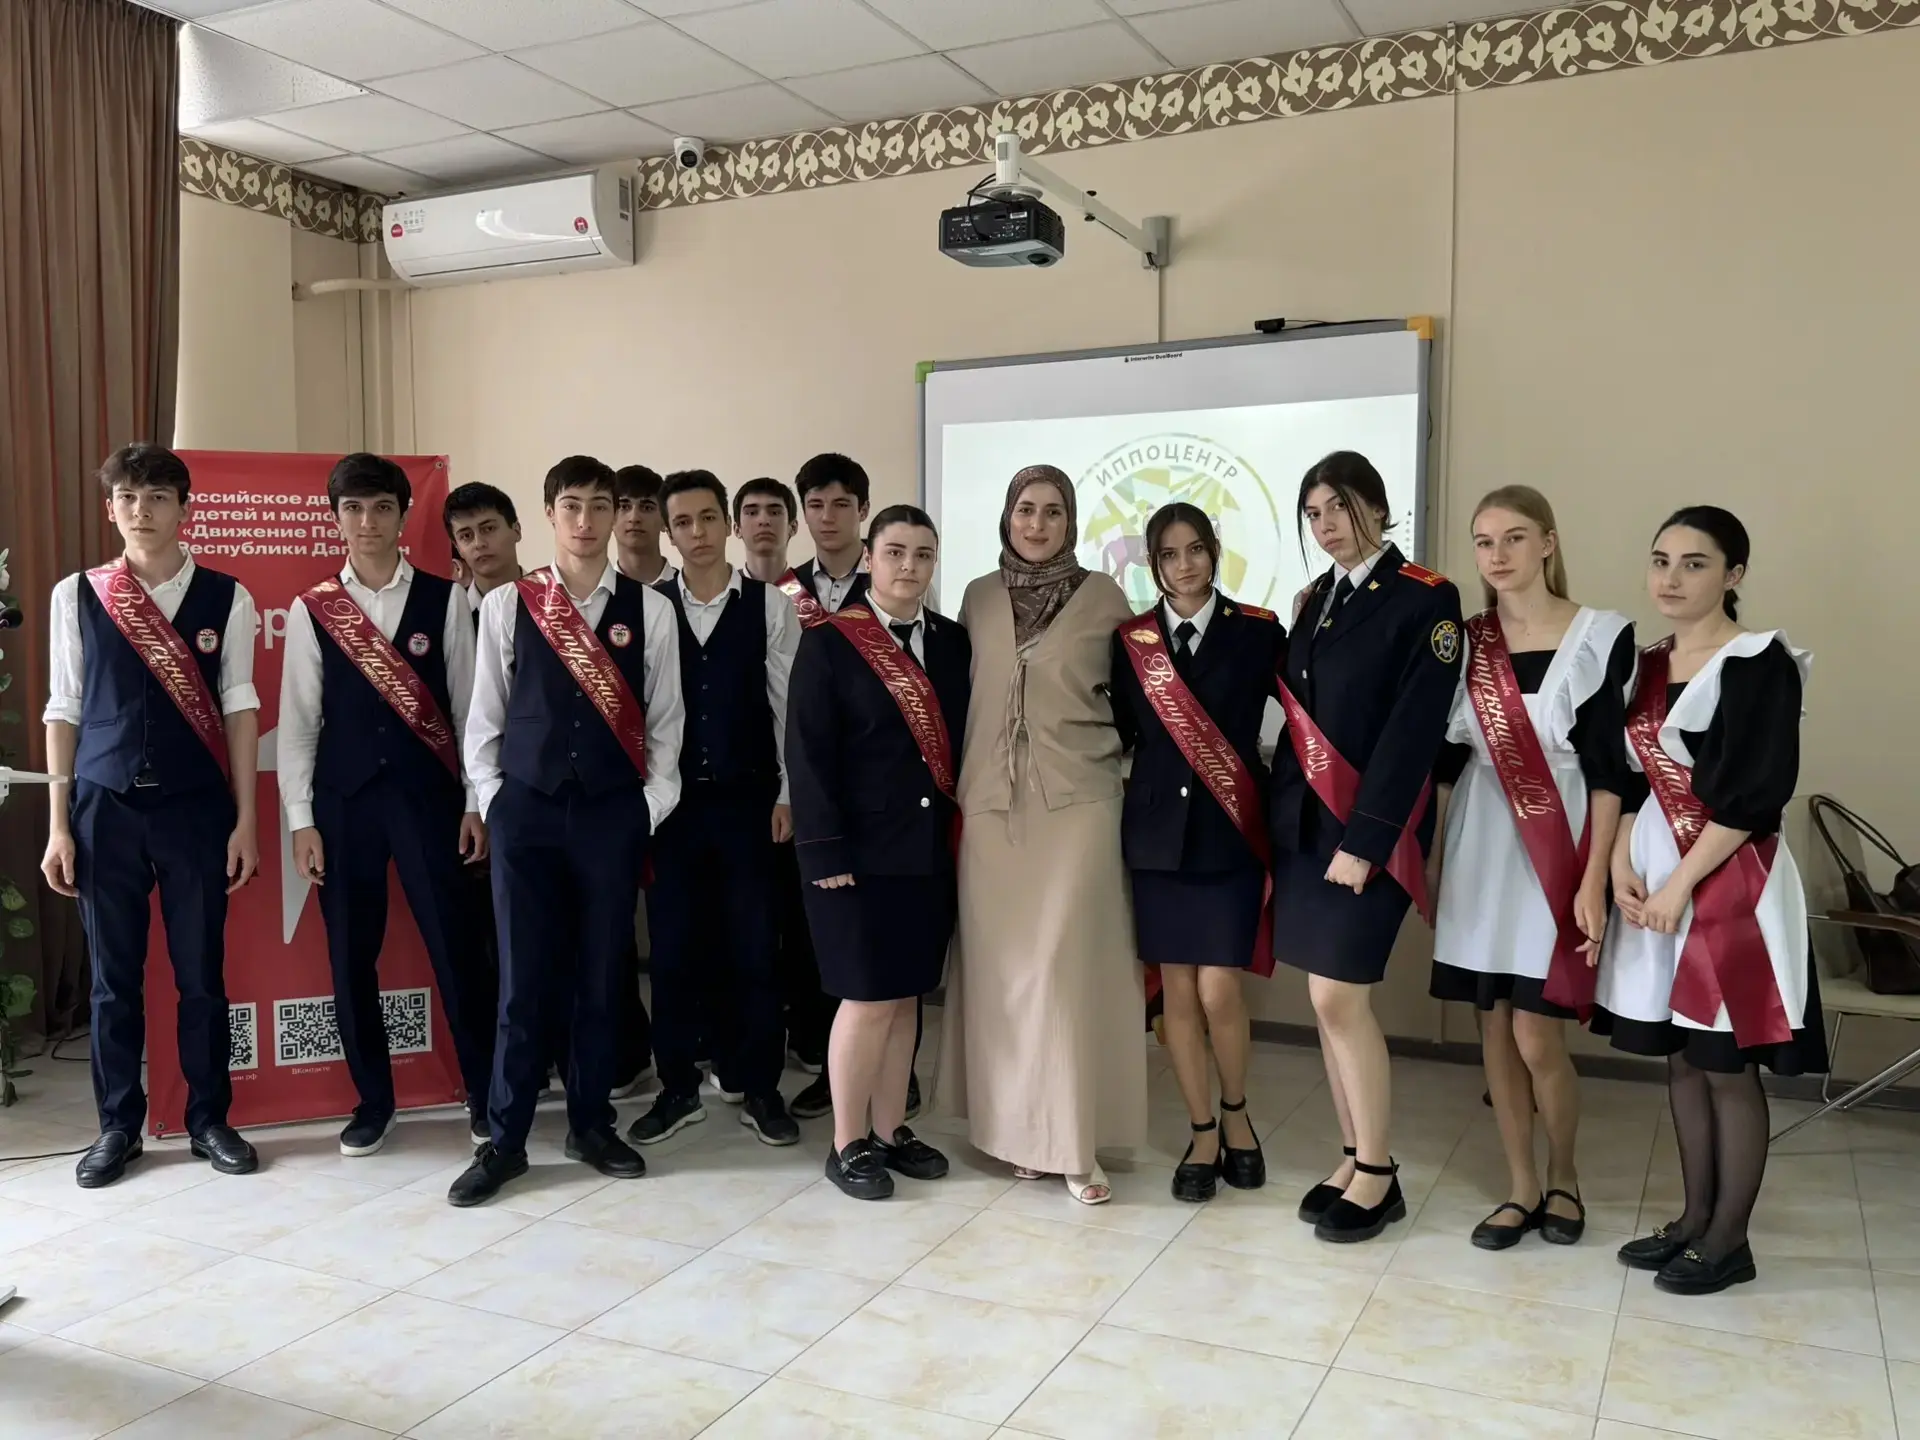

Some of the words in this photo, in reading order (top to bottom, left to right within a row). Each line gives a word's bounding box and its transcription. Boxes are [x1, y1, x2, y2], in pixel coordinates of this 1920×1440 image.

[1095, 443, 1238, 487] ИППОЦЕНТР
[187, 490, 302, 505] оссийское
[192, 507, 257, 522] детей
[262, 511, 276, 521] и
[280, 511, 335, 521] моло
[178, 541, 307, 557] Республики
[182, 524, 307, 539] «Движение
[104, 574, 199, 703] Выпускник
[322, 599, 421, 713] Выпускник
[536, 589, 621, 716] Выпускник
[856, 627, 941, 756] Выпускница
[1142, 653, 1235, 789] Выпускница
[1513, 775, 1557, 815] 2026
